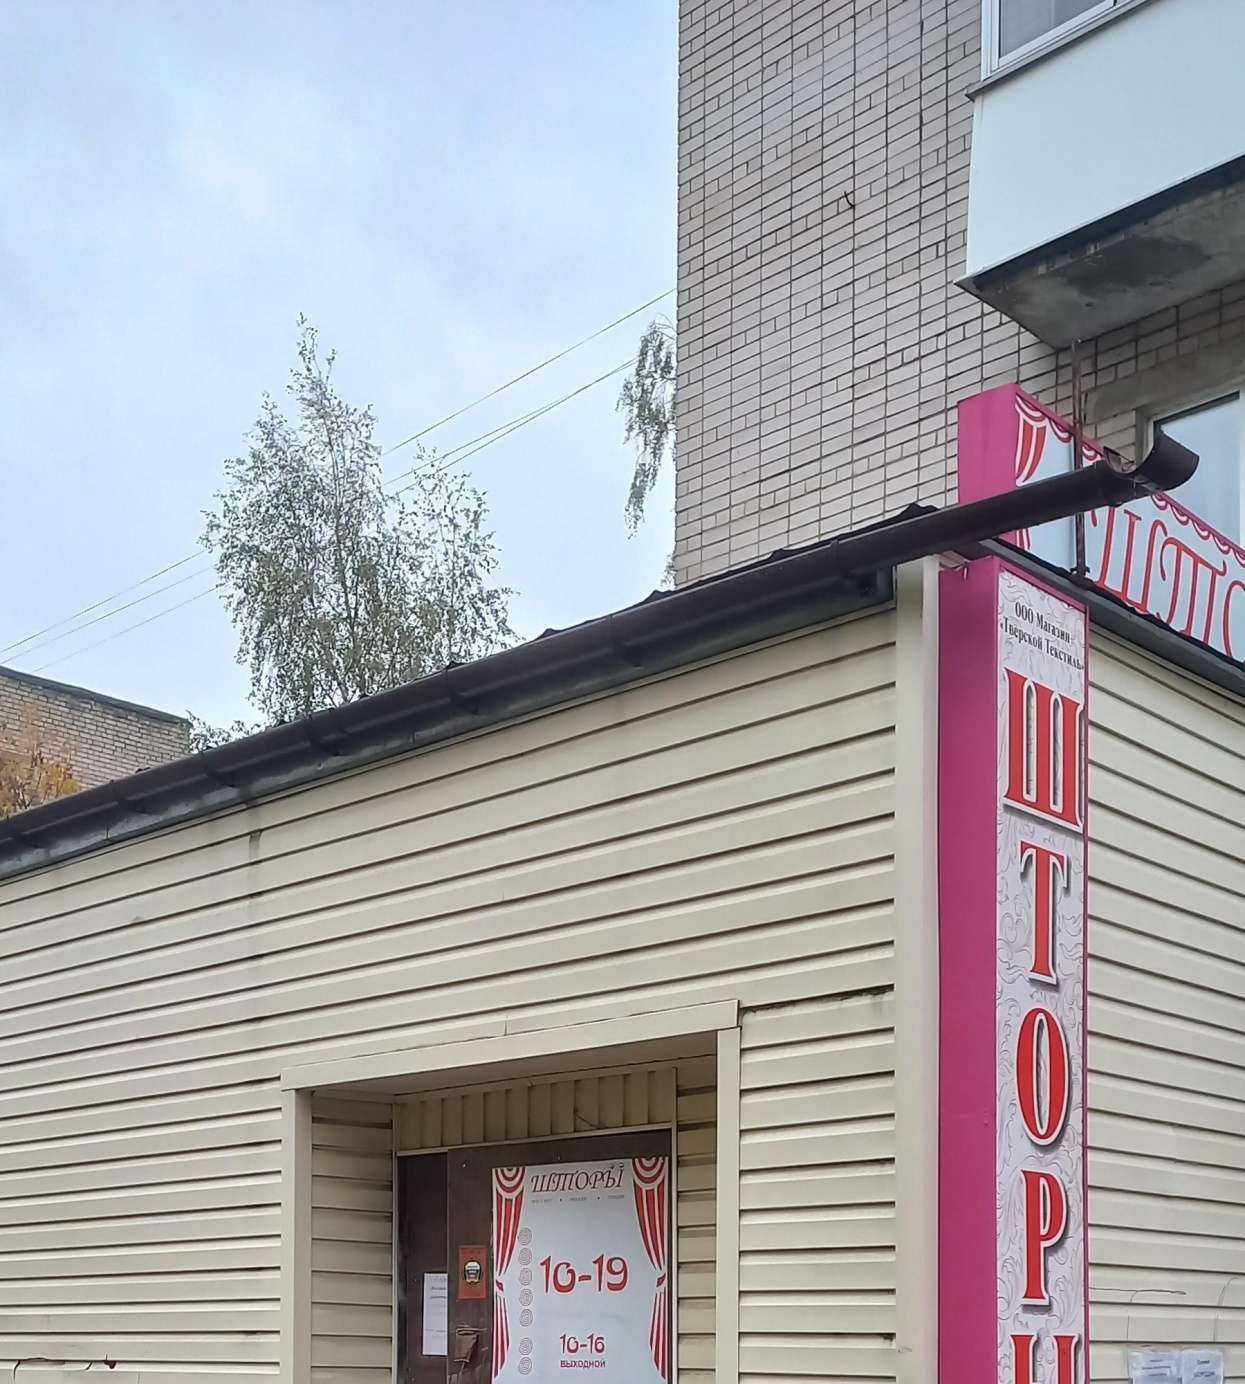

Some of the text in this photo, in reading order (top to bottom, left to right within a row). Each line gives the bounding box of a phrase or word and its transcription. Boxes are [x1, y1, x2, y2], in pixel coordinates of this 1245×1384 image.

[1014, 601, 1071, 644] ООО Магазин
[530, 1163, 624, 1193] ШТОРЫ
[540, 1253, 629, 1294] 10-19
[560, 1332, 606, 1354] 10-16
[560, 1358, 606, 1369] ВЫХОДНОЙ
